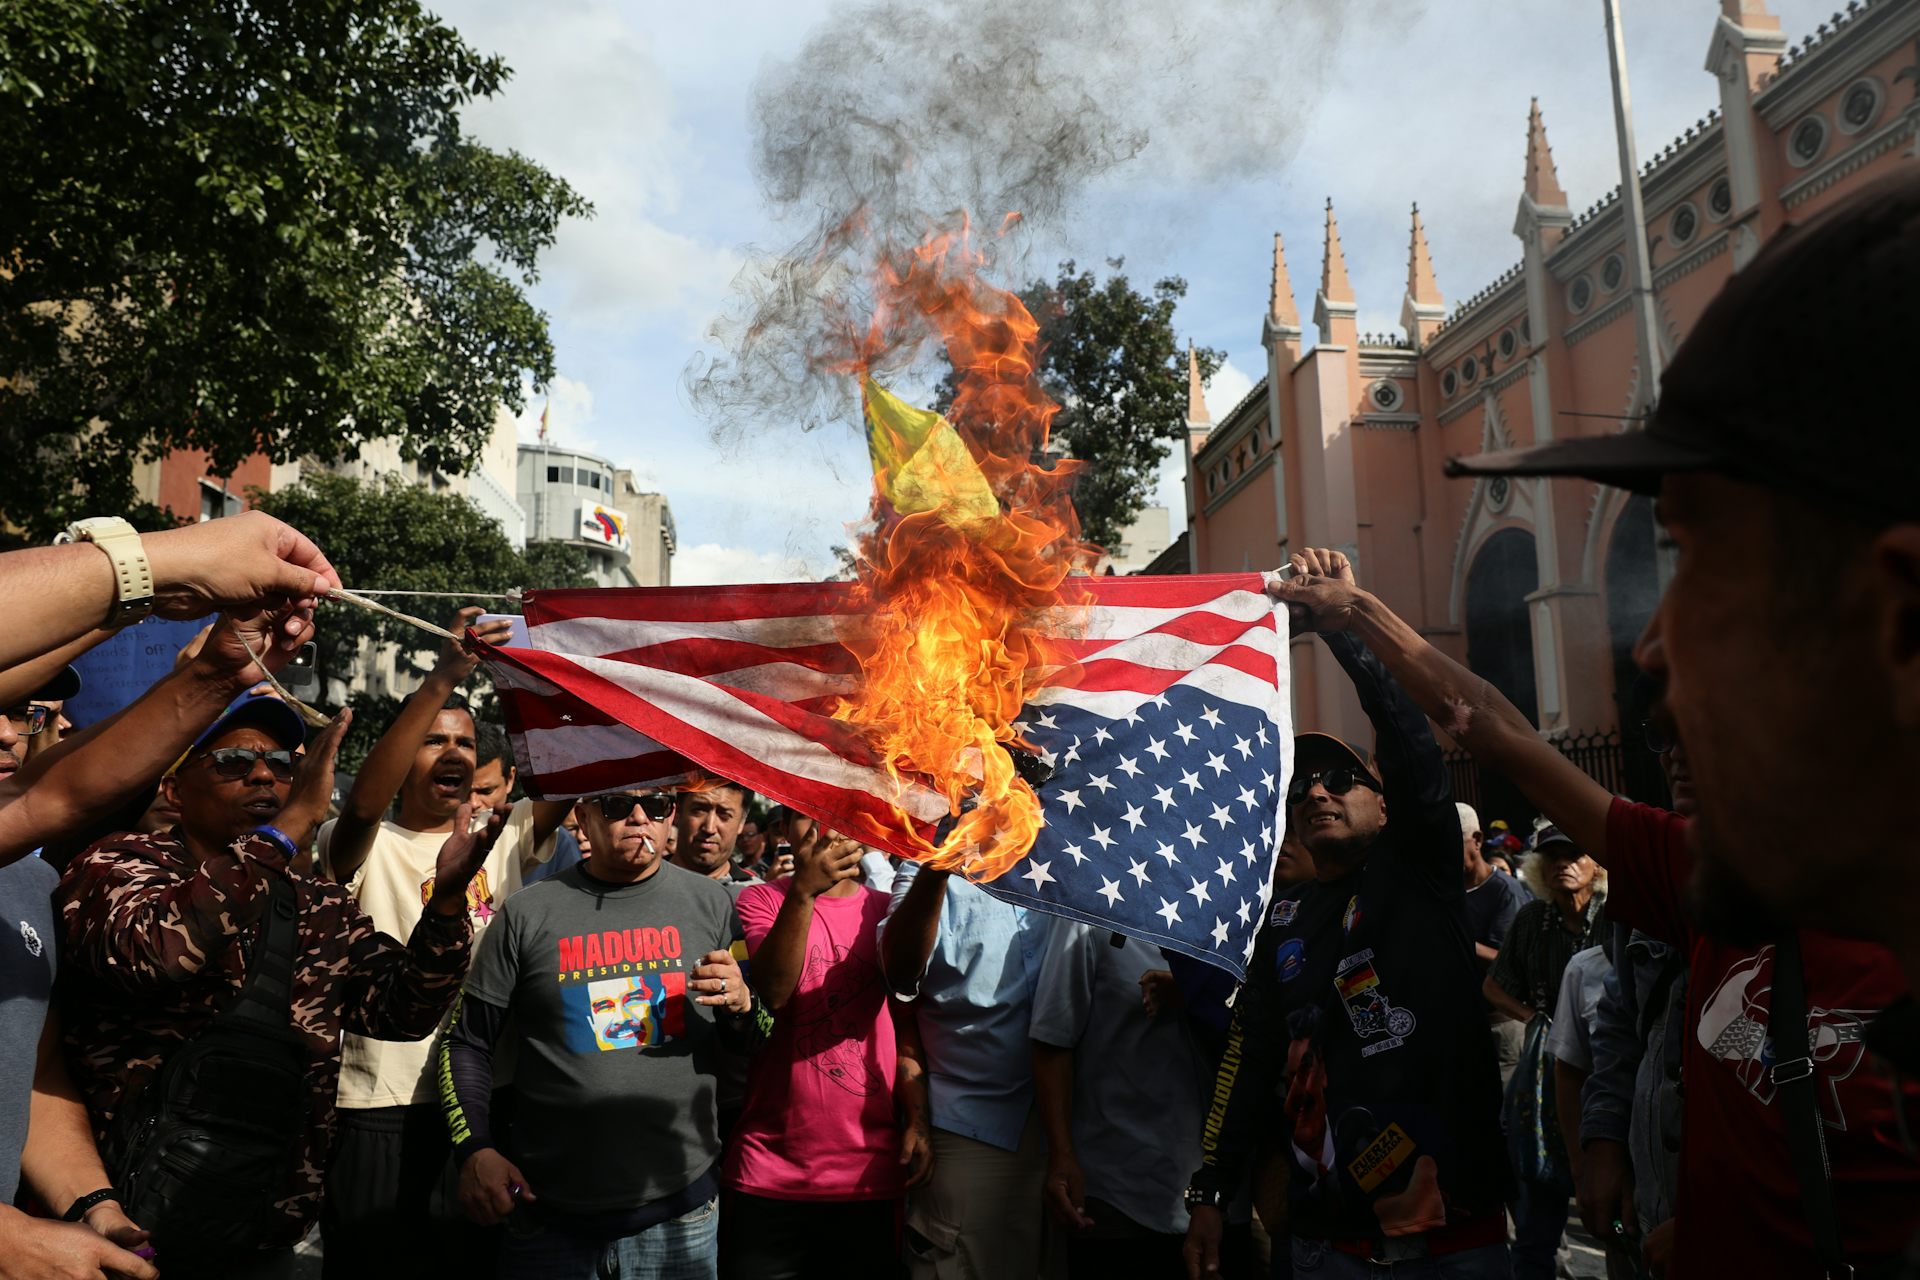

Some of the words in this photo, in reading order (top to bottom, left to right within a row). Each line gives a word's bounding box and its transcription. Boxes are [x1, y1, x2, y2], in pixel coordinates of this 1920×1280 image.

[559, 925, 682, 973] MADURO
[558, 959, 682, 982] PRESIDENTE
[1352, 1129, 1399, 1176] FUERZA
[1375, 1156, 1396, 1179] TV
